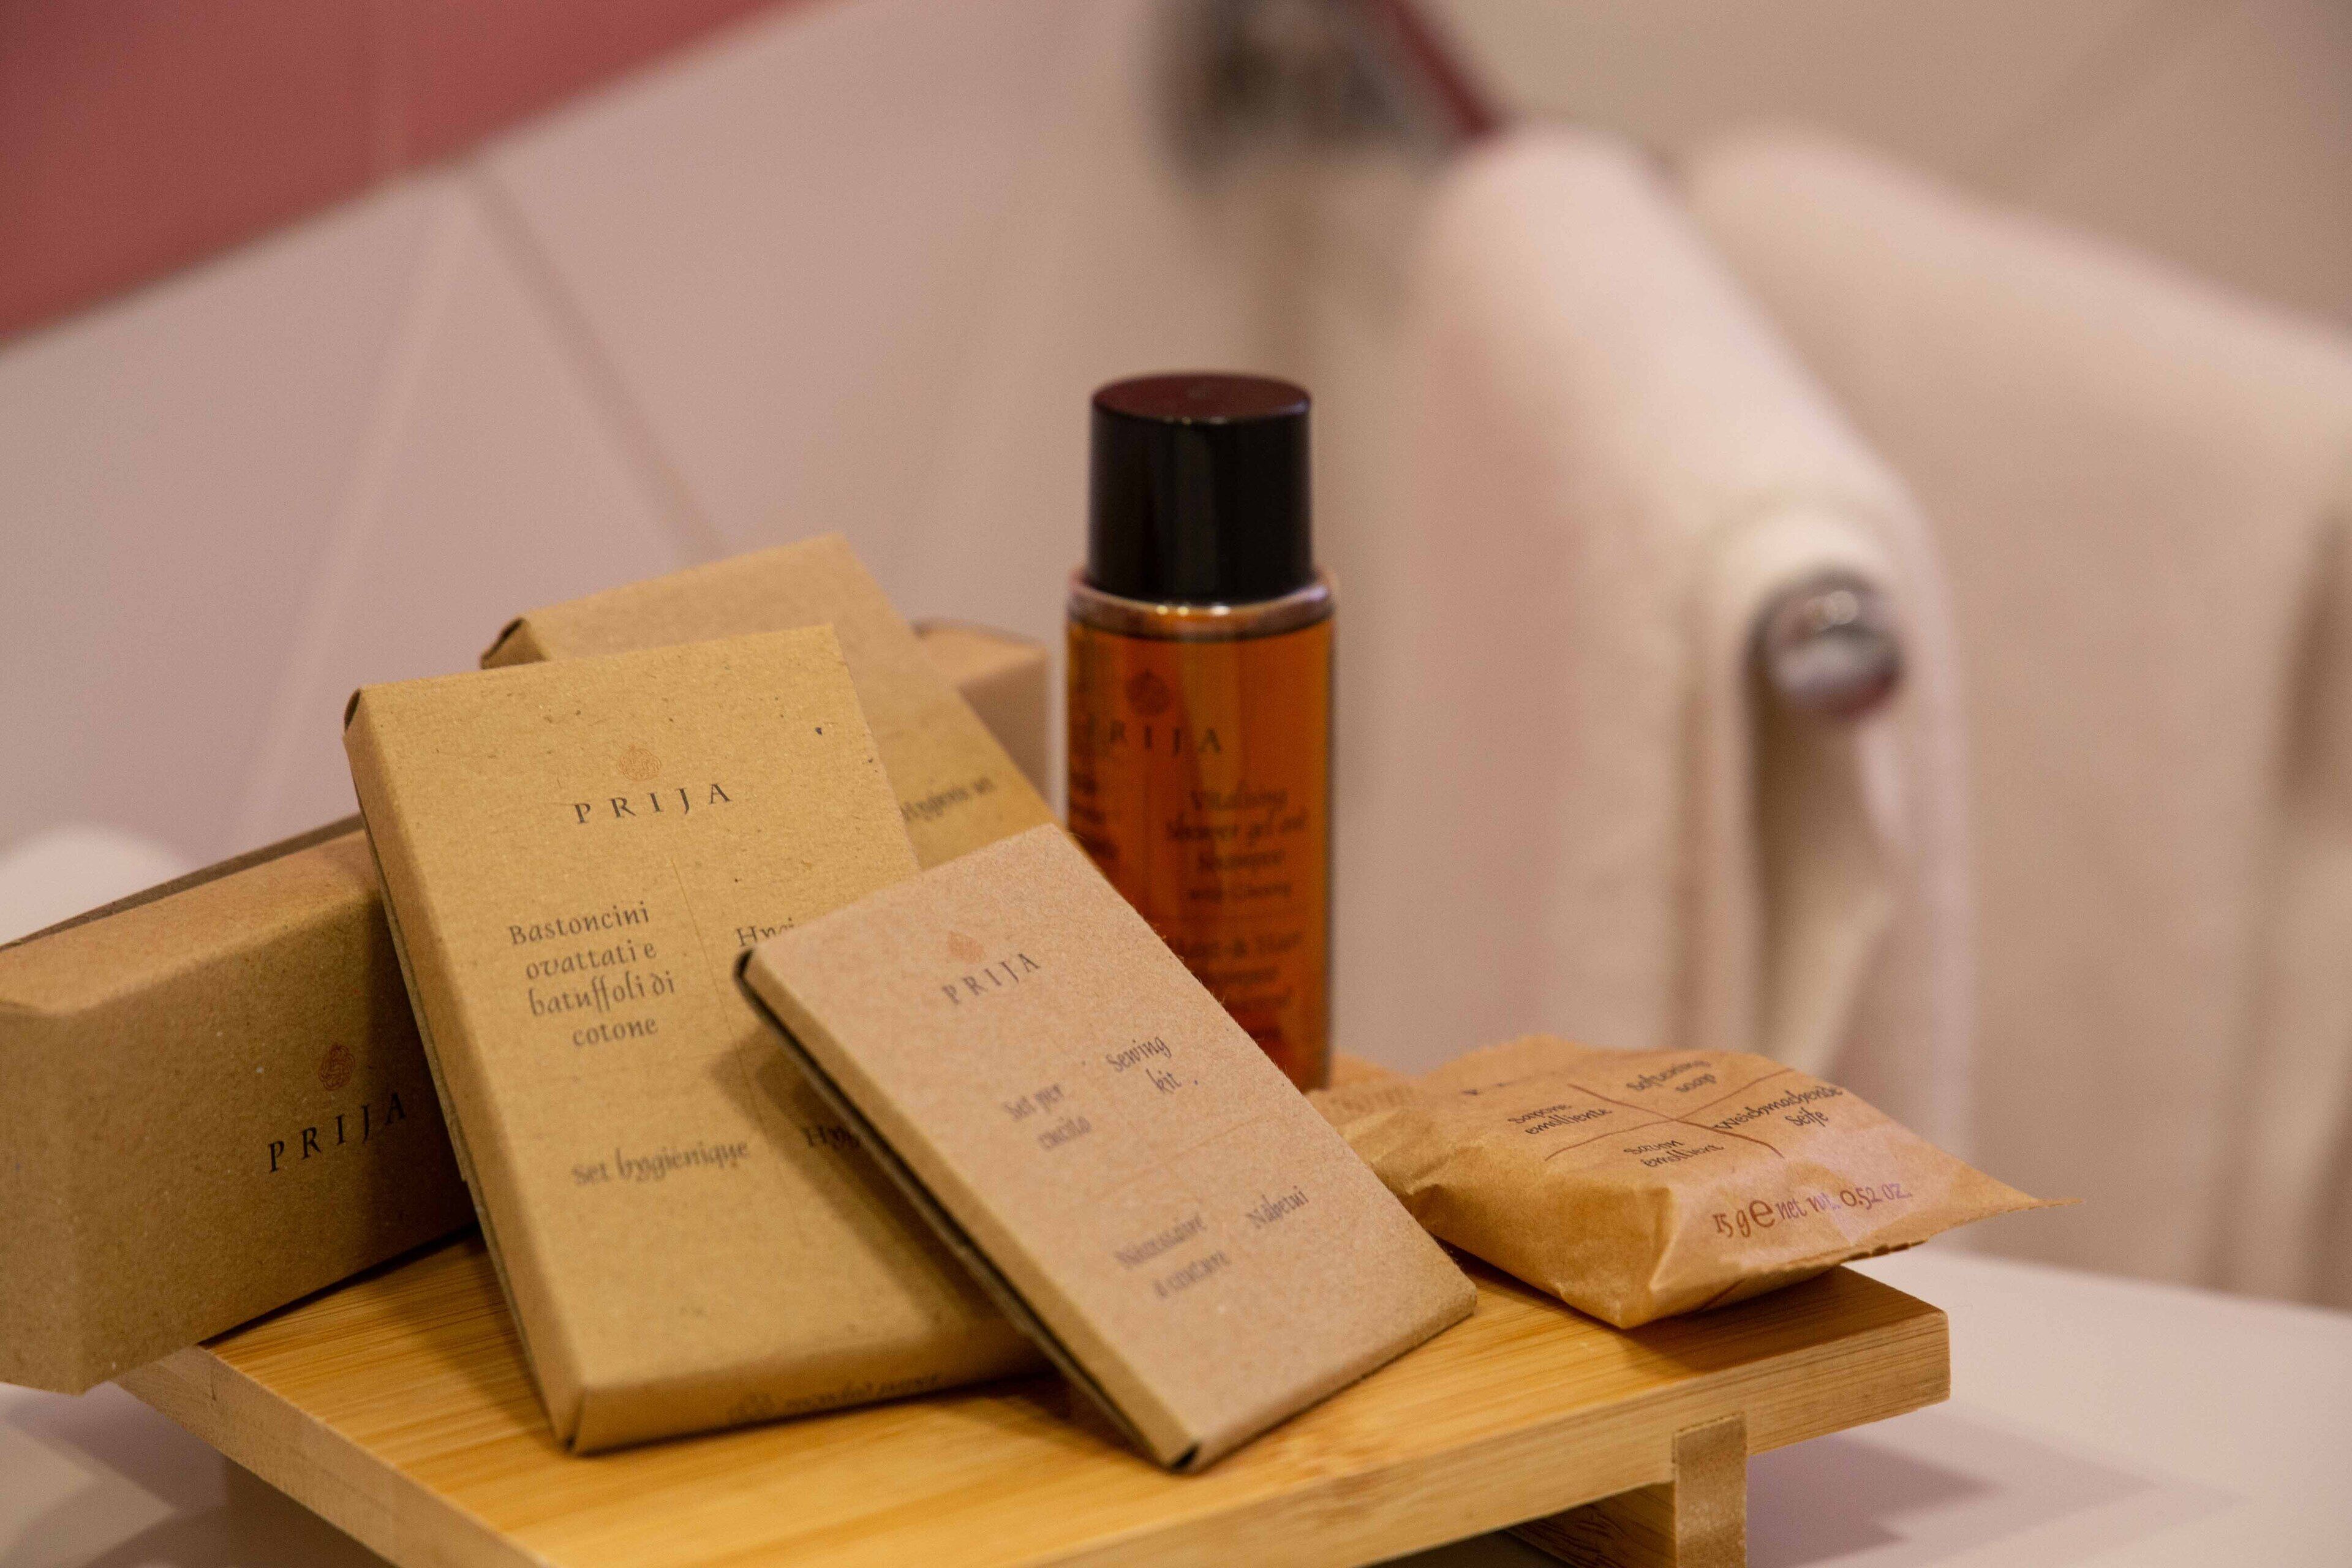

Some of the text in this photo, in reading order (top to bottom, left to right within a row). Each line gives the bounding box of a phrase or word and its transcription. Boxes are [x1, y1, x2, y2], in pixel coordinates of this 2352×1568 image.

[574, 783, 733, 824] PRIJA
[508, 900, 650, 946] Bastoncini
[526, 939, 657, 980] ovattati e
[941, 953, 1040, 1005] PRIJA
[529, 971, 675, 1017] batuffoli di
[573, 1017, 658, 1048] cotone
[1106, 1035, 1172, 1072] Sewing
[1145, 1068, 1182, 1094] kit
[268, 1093, 407, 1174] PRIJA
[1713, 1212, 1734, 1238] 15
[1736, 1208, 1752, 1238] g
[1776, 1197, 1807, 1221] net
[1839, 1186, 1883, 1211] 0.52
